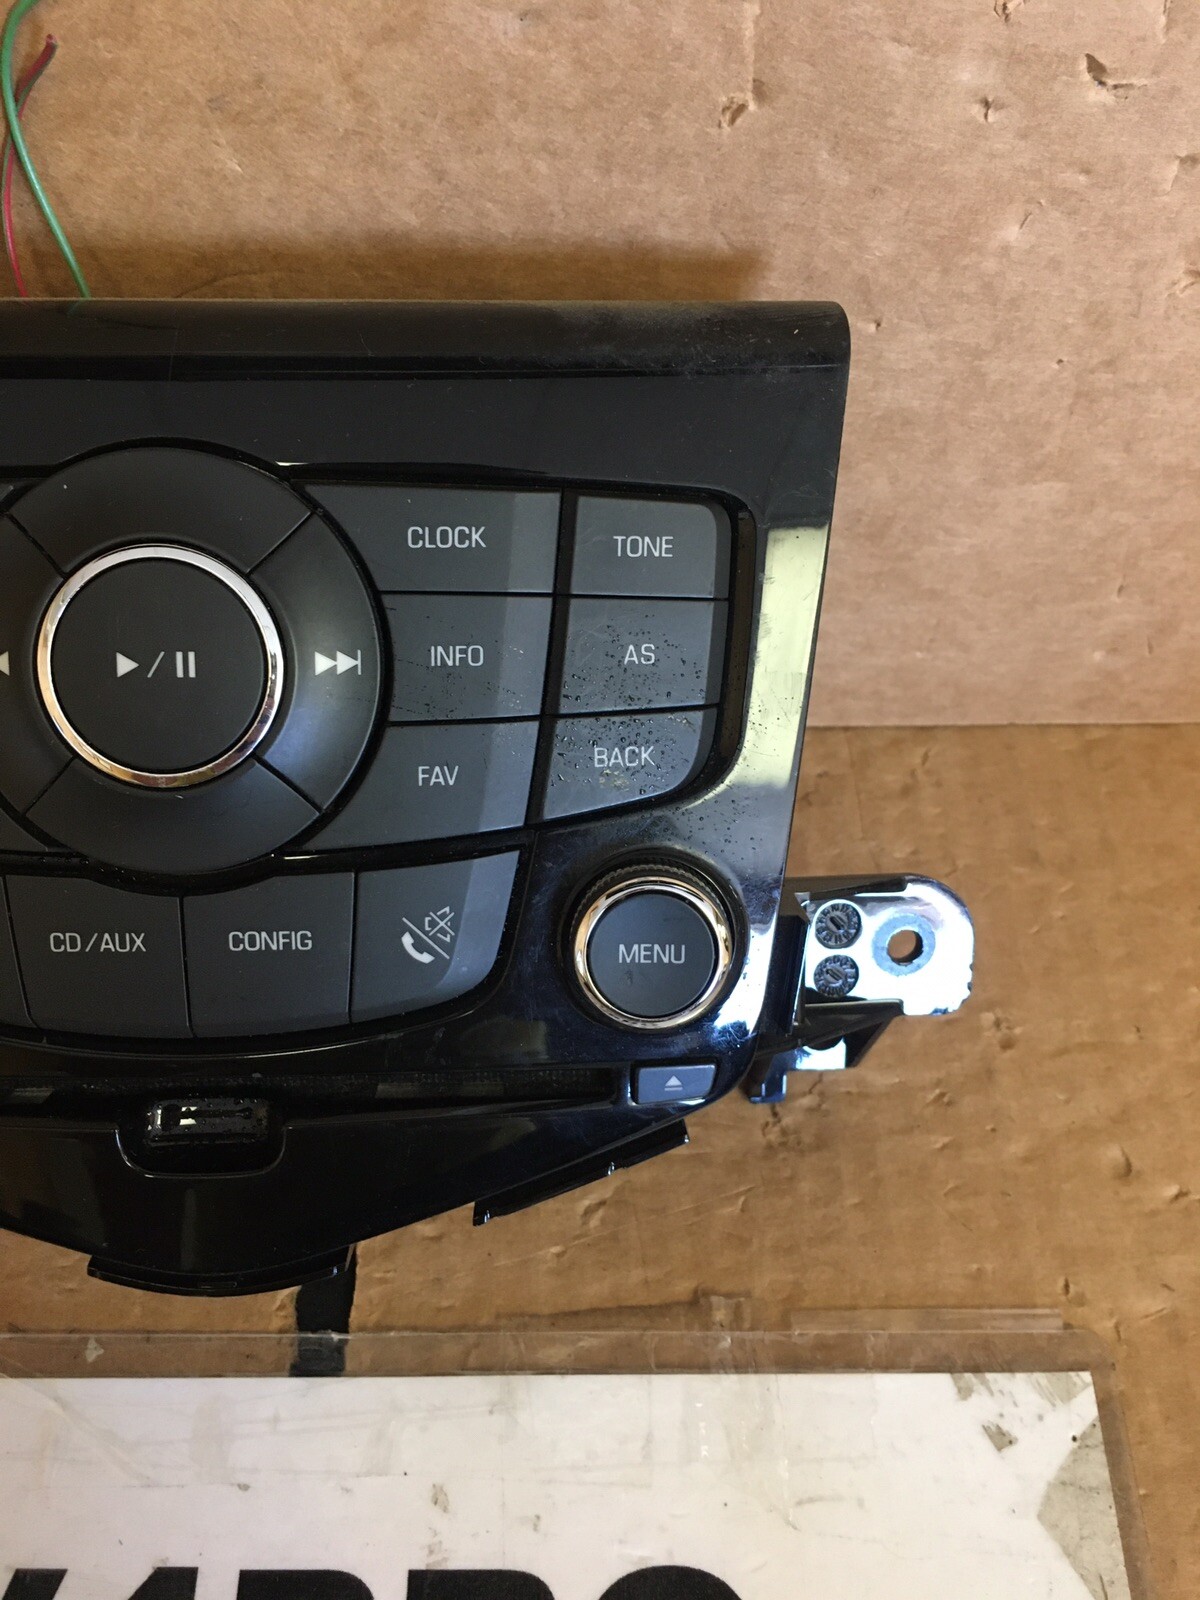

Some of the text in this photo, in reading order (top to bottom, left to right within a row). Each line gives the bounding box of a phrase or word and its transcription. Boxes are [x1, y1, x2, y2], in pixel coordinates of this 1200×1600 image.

[407, 526, 487, 549] CLOCK
[613, 535, 674, 558] TONE
[430, 645, 484, 667] INFO
[624, 643, 655, 665] AS
[593, 746, 655, 768] BACK
[417, 765, 459, 787] FAV
[49, 932, 147, 953] CD/AUX
[228, 931, 313, 951] CONFIG
[618, 943, 686, 965] MENU
